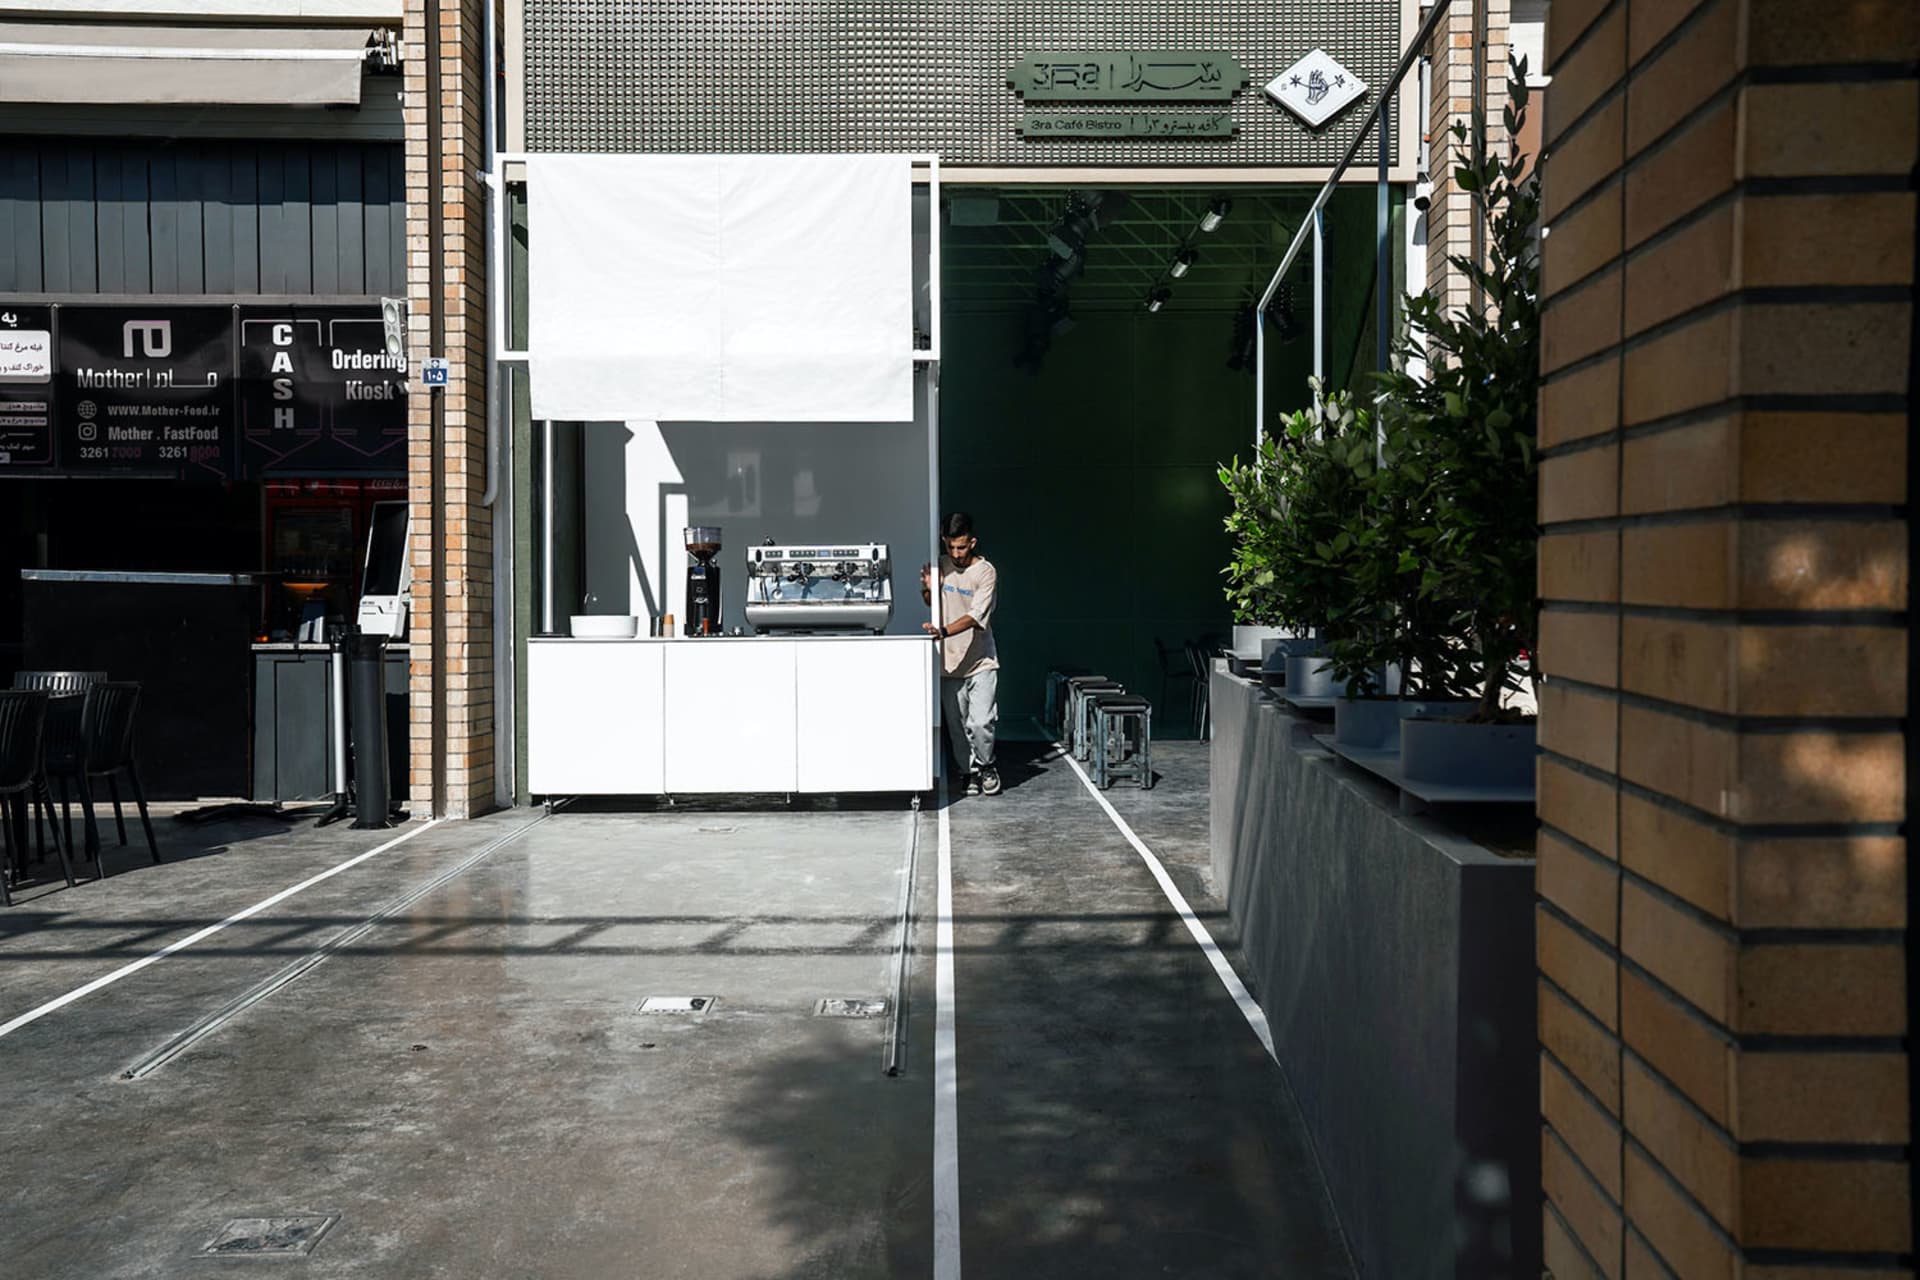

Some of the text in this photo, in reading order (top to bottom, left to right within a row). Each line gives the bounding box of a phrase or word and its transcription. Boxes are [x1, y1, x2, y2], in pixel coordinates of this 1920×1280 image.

[1031, 119, 1123, 130] 3ra Café Bistro
[332, 349, 407, 373] Ordering
[77, 368, 144, 388] Mother
[345, 380, 394, 400] Kiosk
[108, 426, 153, 441] Mother
[163, 426, 219, 441] FastFood
